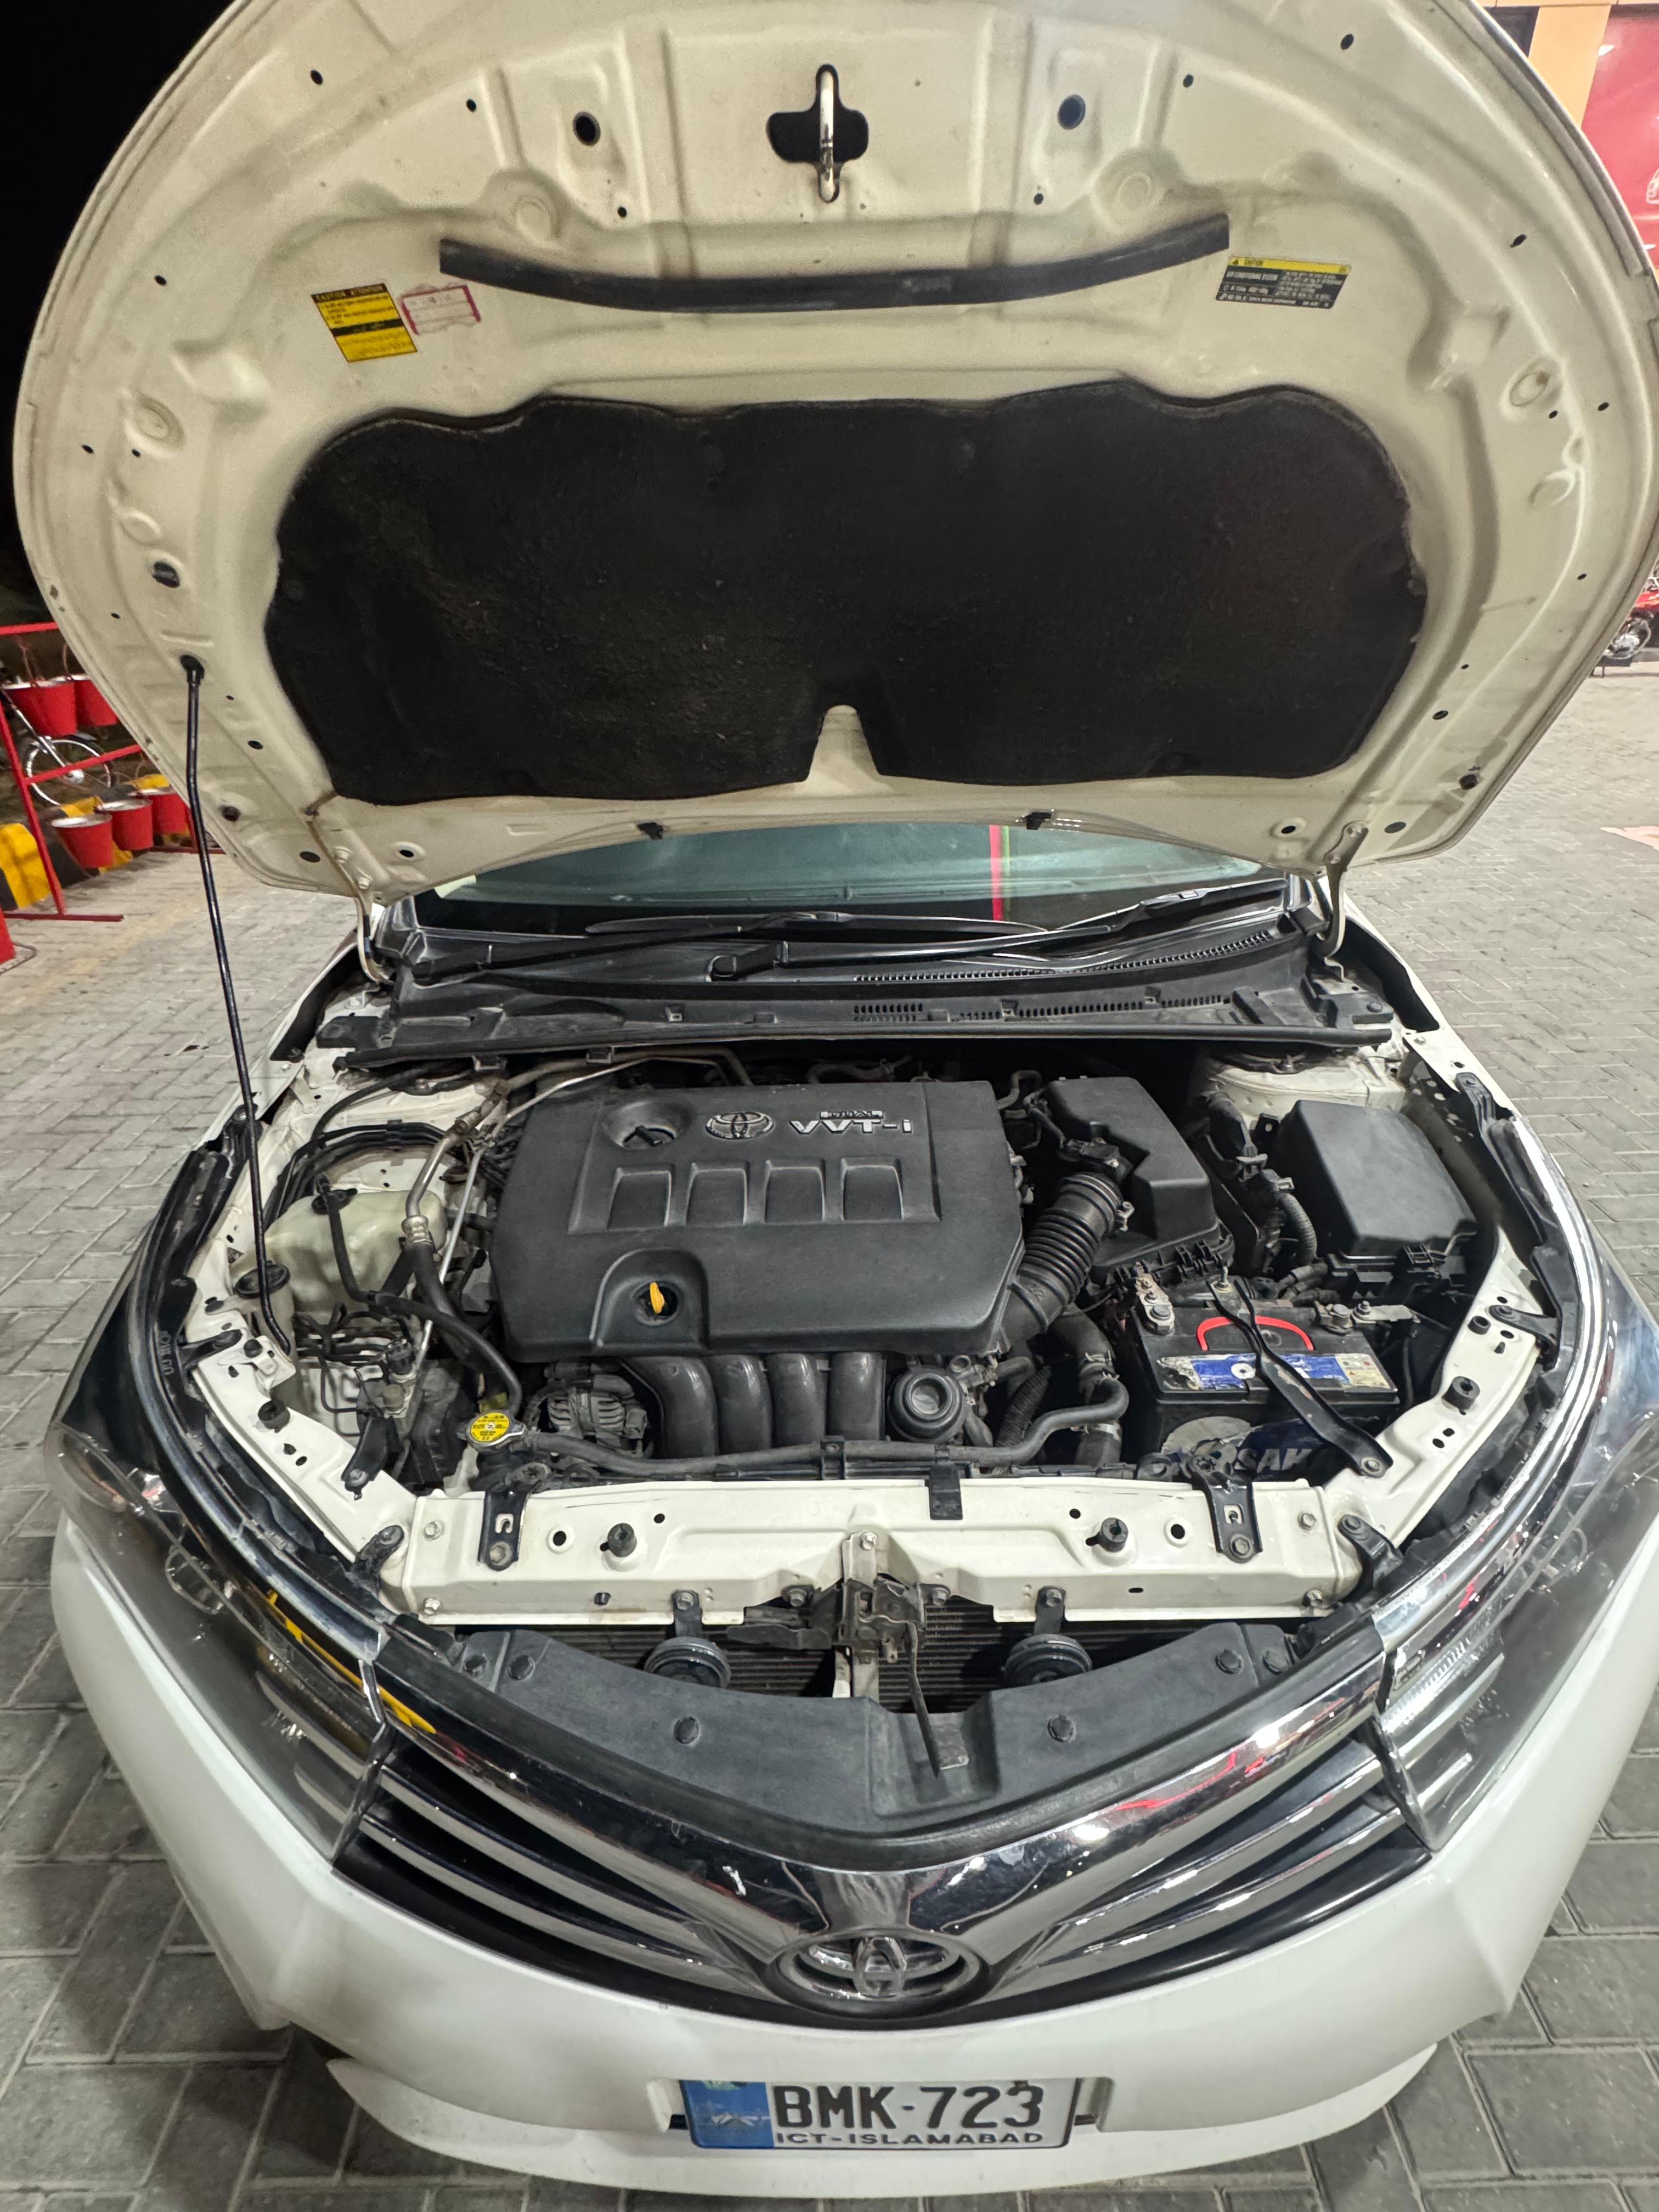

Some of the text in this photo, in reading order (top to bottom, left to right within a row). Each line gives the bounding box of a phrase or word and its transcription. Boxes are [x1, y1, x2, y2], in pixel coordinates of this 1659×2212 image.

[789, 1119, 912, 1134] VVT-i
[774, 2085, 1043, 2129] BMK-723
[777, 2133, 1043, 2145] ICT-ISLAMABAD
